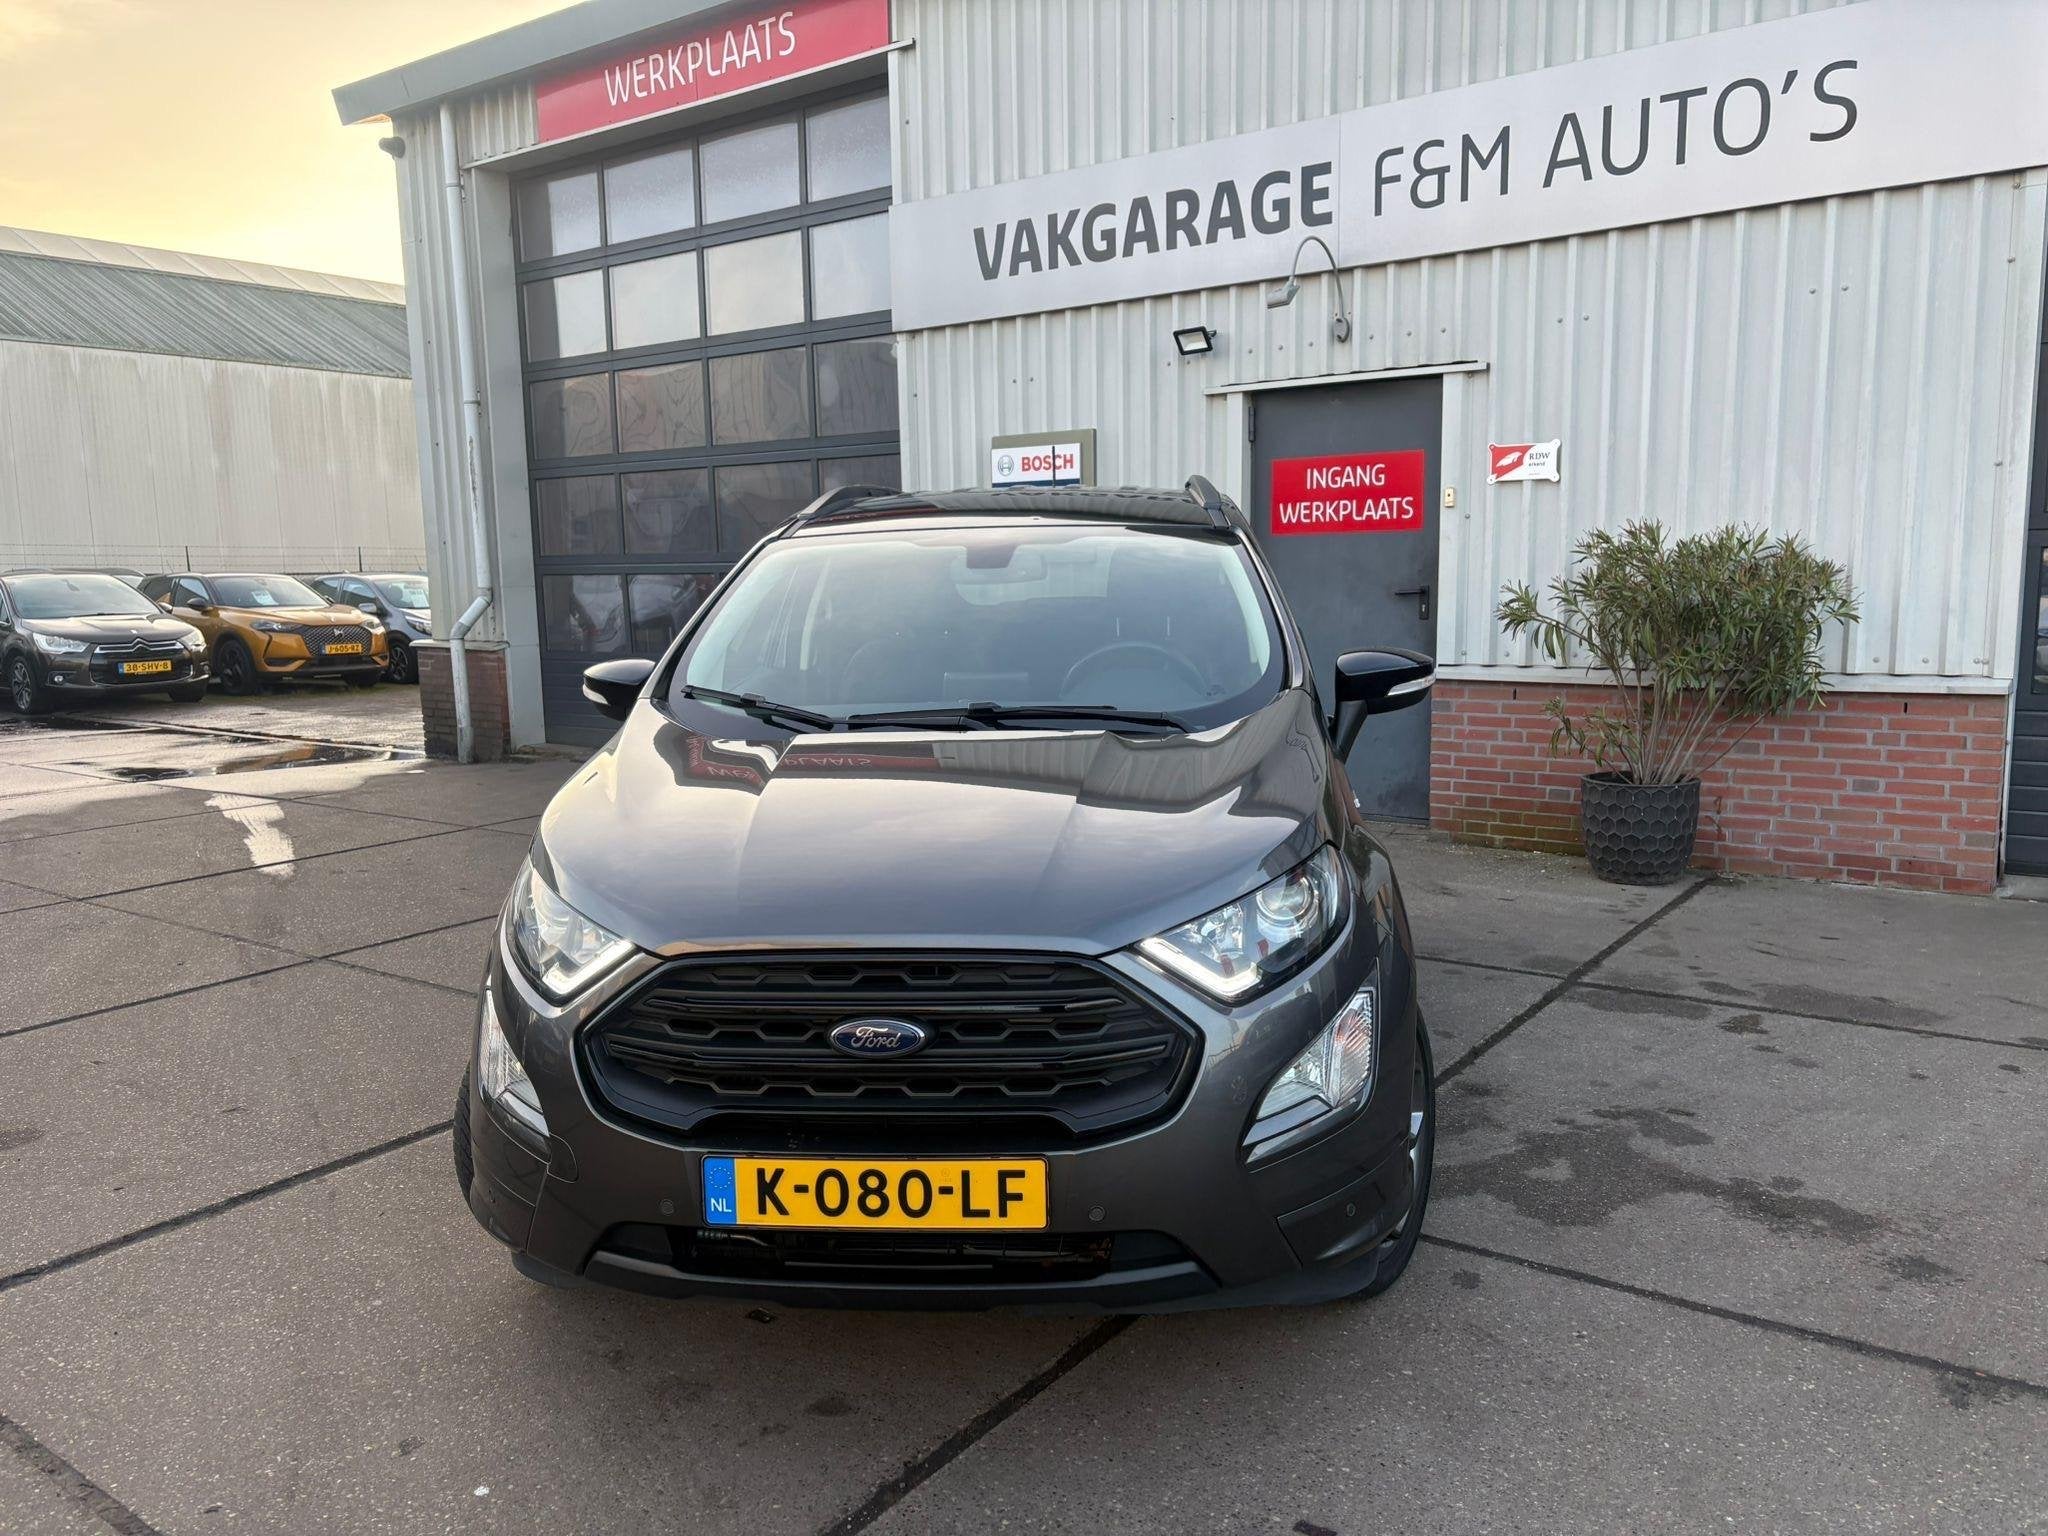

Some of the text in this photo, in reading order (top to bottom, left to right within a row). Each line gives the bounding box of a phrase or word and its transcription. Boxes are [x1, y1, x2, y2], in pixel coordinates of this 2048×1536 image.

[604, 11, 796, 107] WERKPLAATS
[973, 59, 1858, 281] VAKGARAGE F&M AUTO'S
[1021, 453, 1074, 472] BOSCH
[1529, 452, 1551, 460] RDW
[1306, 464, 1386, 490] INGANG
[1279, 496, 1414, 524] WERKPLAATS
[126, 661, 169, 672] 38-SHV-8
[850, 1026, 901, 1049] Ford
[710, 1167, 1026, 1218] NL K-080-LF
